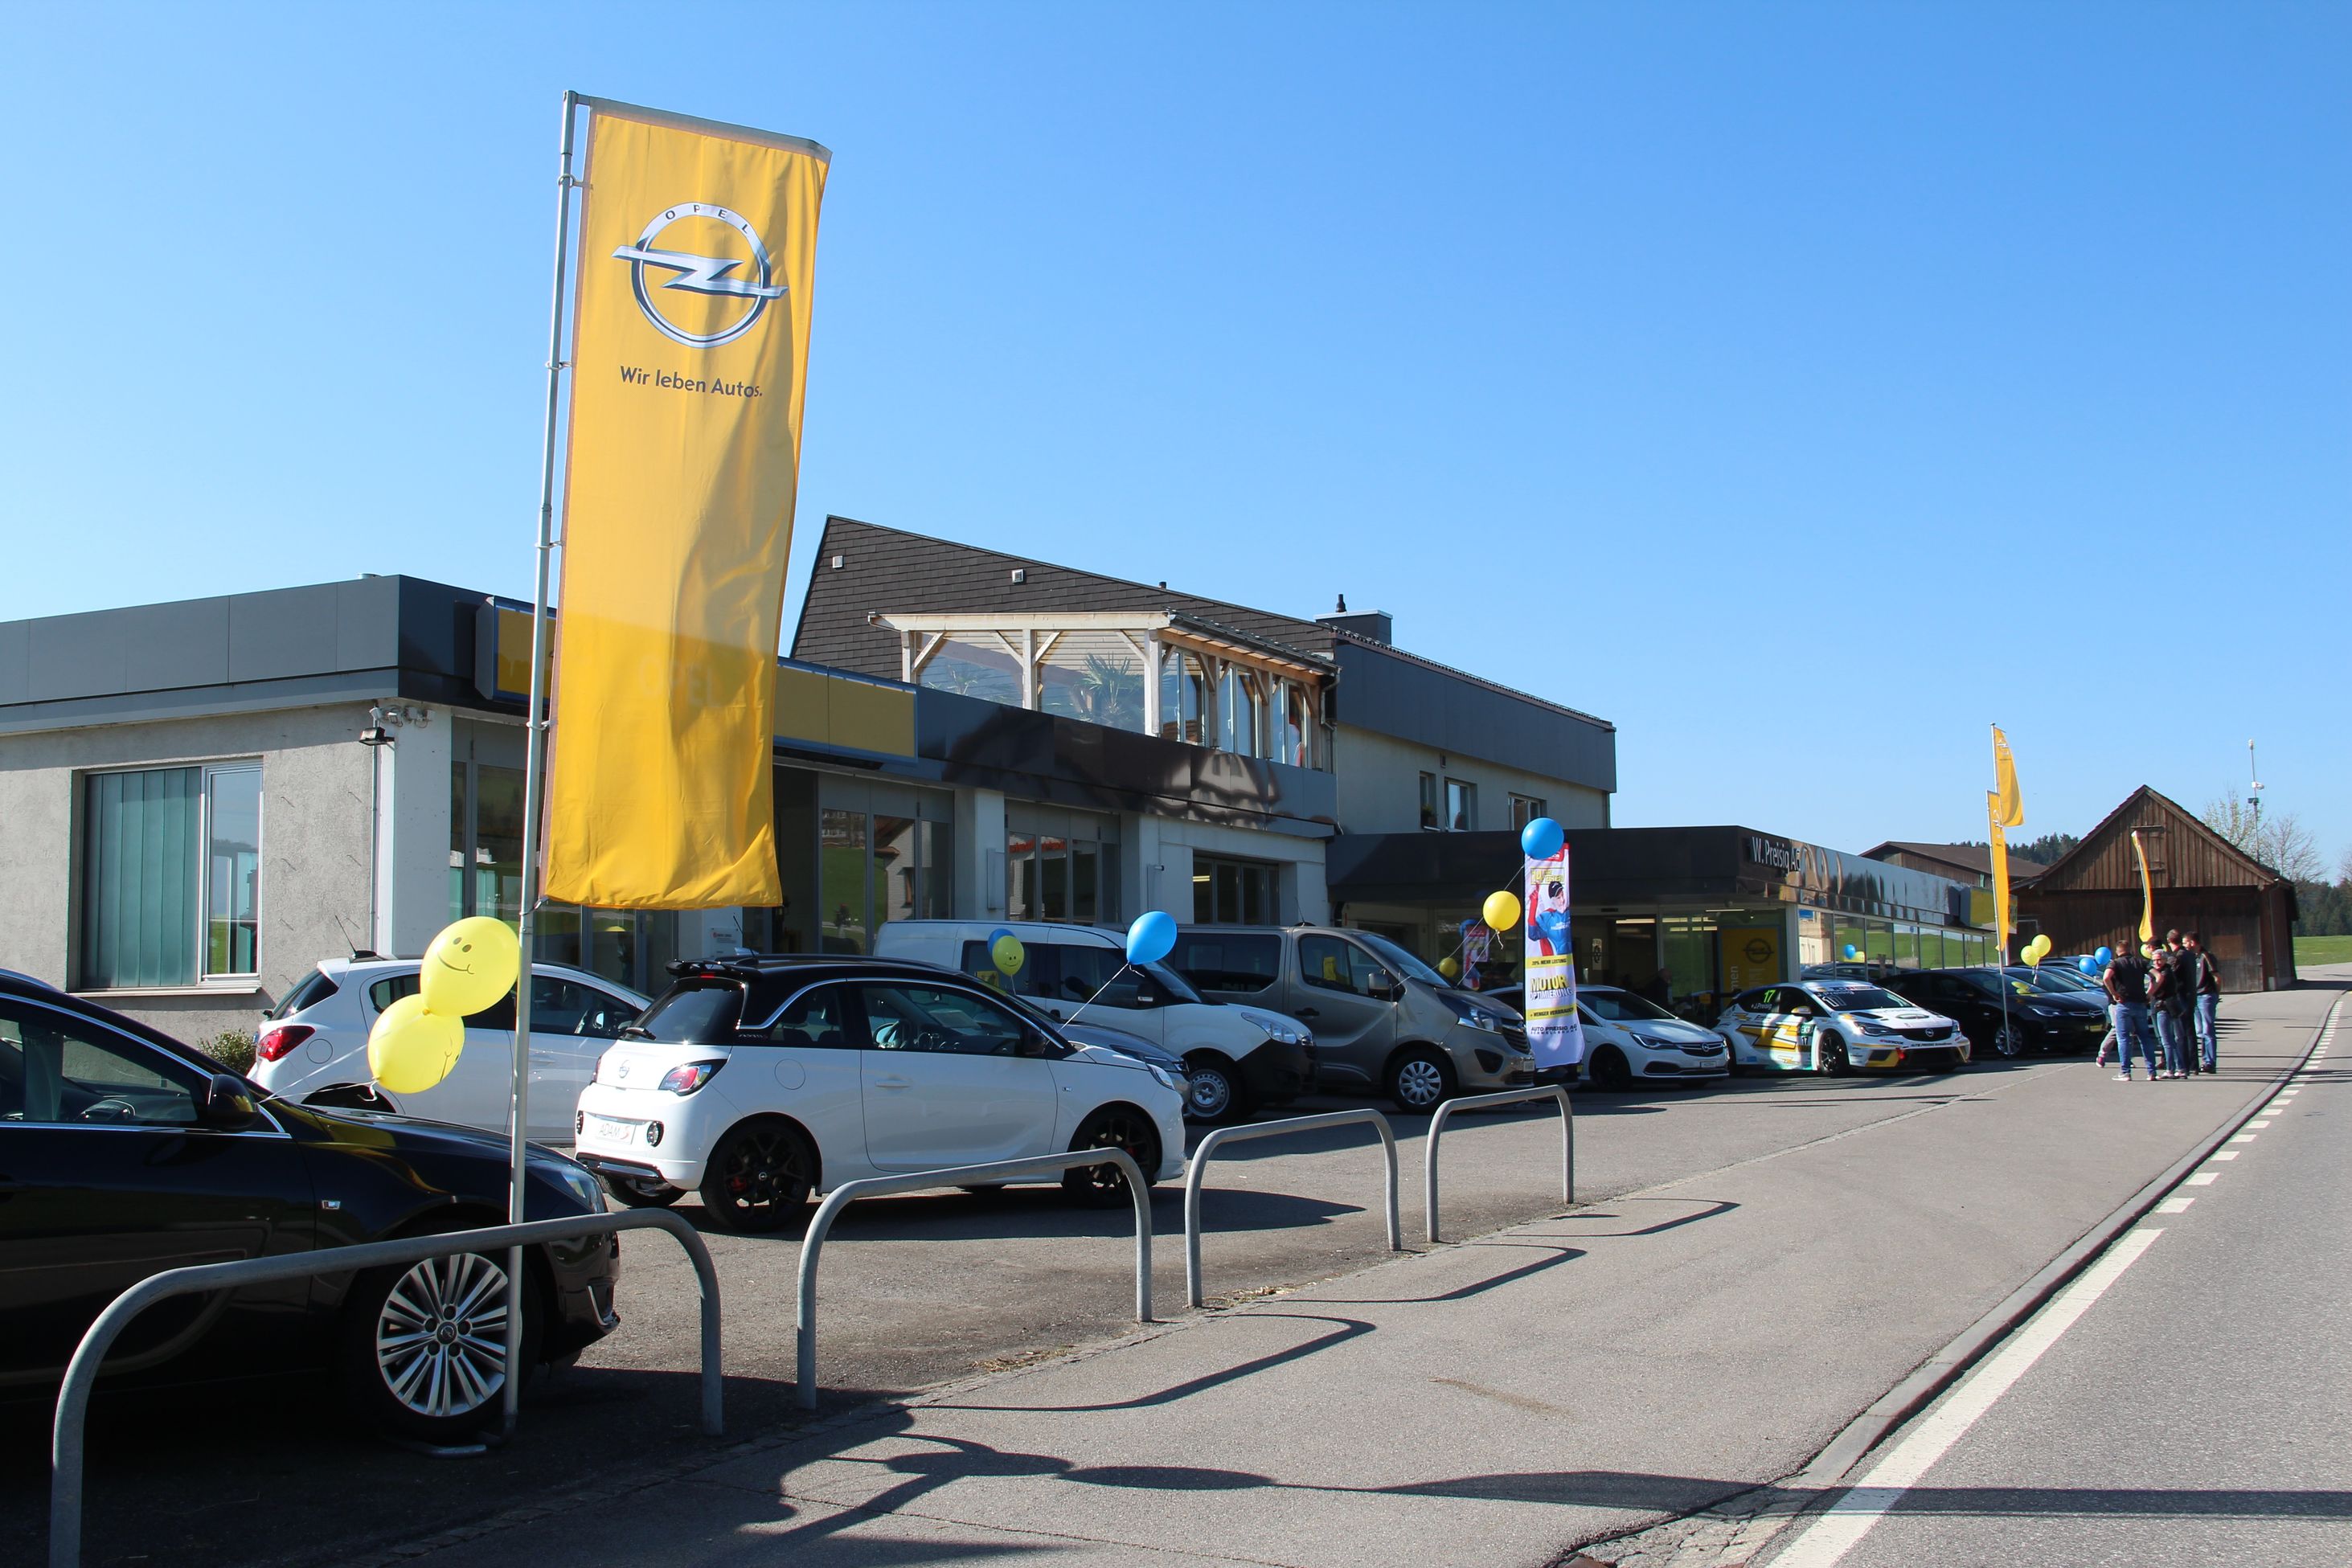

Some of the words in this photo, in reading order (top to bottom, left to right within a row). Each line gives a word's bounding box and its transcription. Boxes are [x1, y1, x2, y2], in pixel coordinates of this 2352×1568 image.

[664, 203, 752, 235] OPEL
[620, 365, 651, 386] Wir
[655, 369, 707, 393] leben
[711, 377, 764, 399] Autos.
[1752, 836, 1764, 864] W.
[1764, 839, 1790, 877] Preisig
[1790, 848, 1801, 871] AG
[1530, 976, 1568, 992] MOTOR
[1529, 988, 1573, 1001] OPTIMIERUNG
[1764, 989, 1776, 1004] 17
[599, 1123, 621, 1138] ADAM
